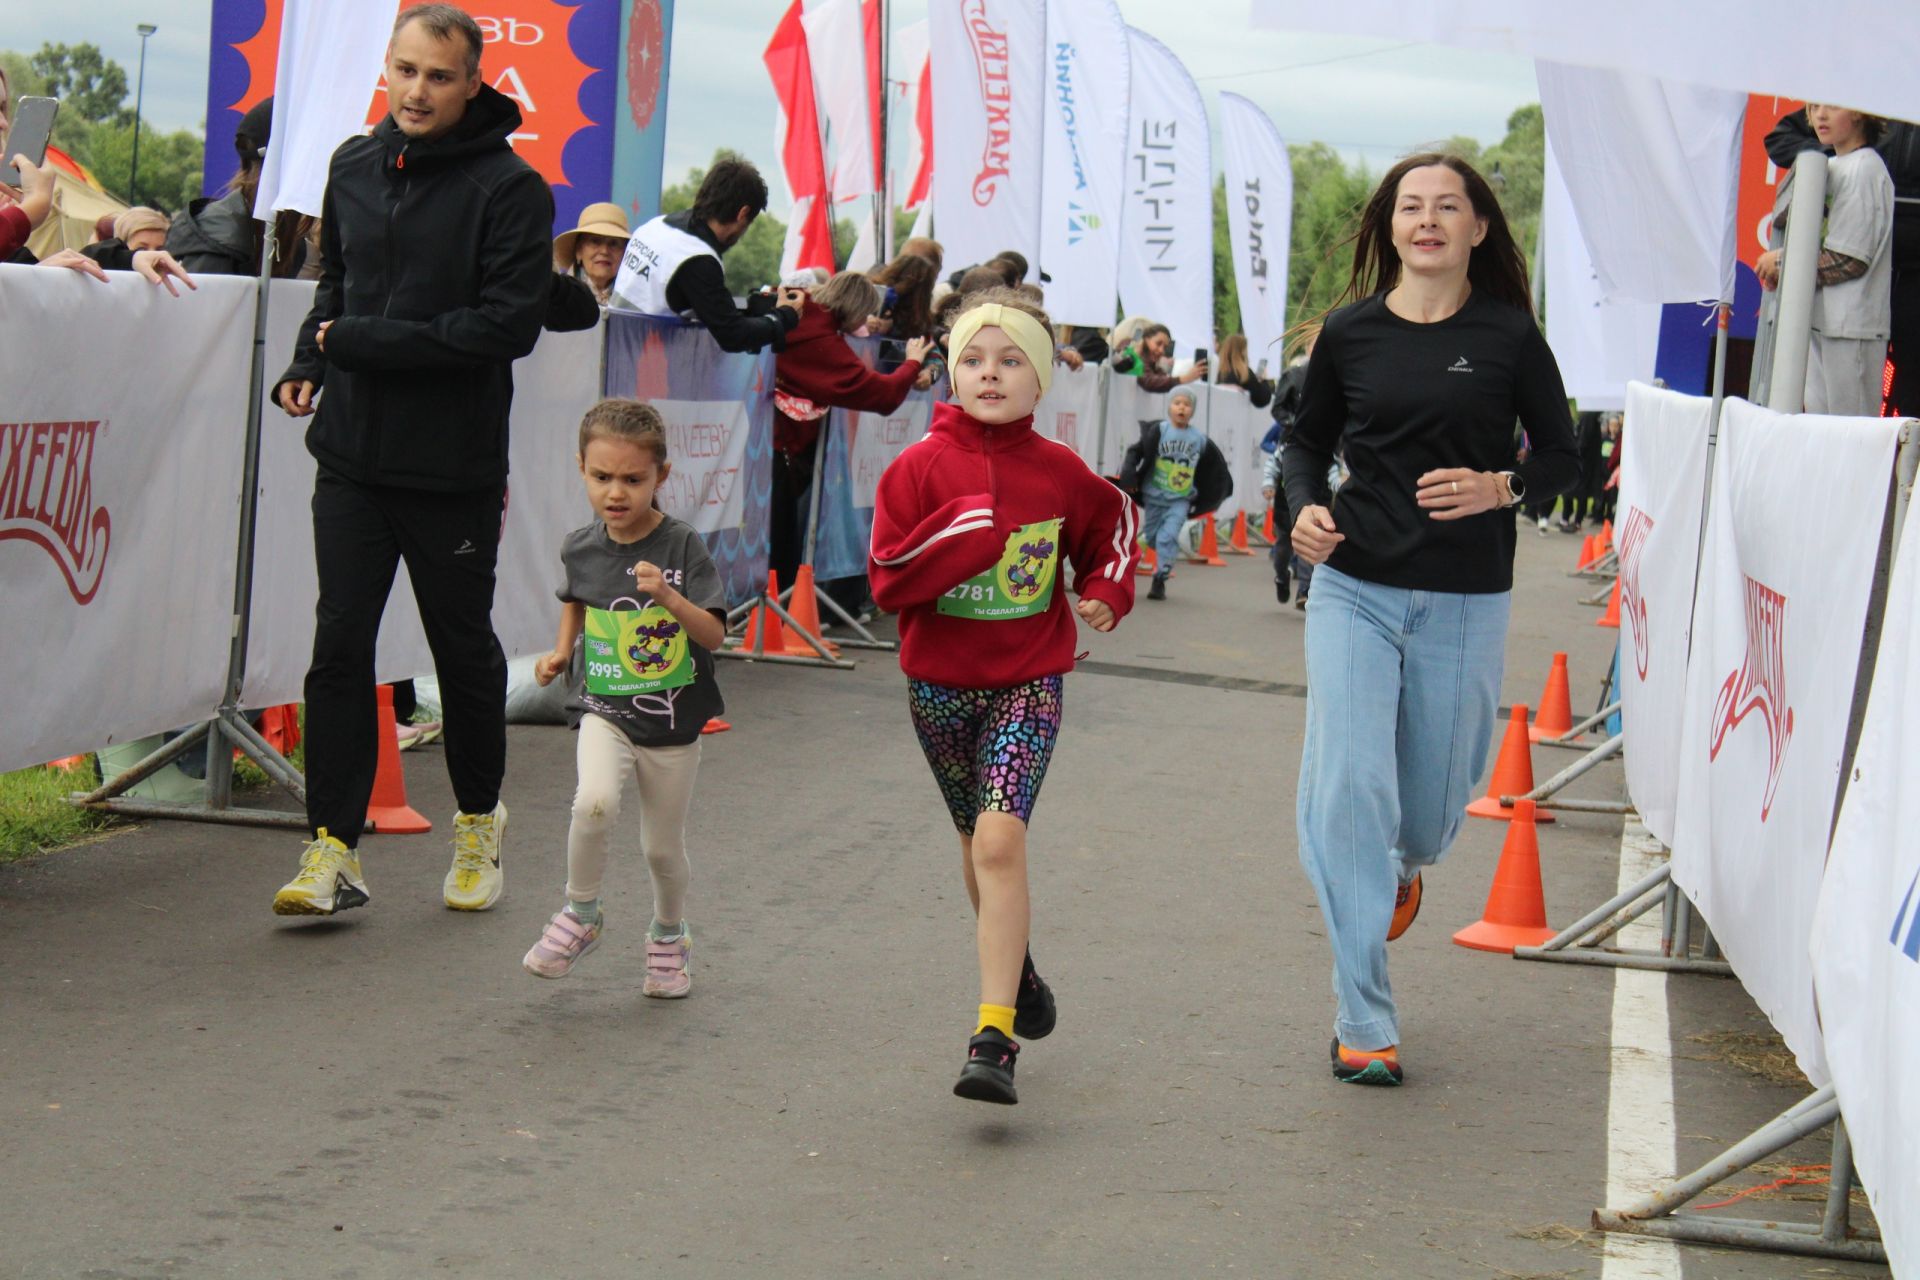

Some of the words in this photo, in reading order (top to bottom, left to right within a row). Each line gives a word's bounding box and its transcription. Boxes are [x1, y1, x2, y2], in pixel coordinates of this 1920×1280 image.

[630, 238, 660, 267] OFFICIAL
[944, 584, 994, 602] 2781
[986, 607, 1015, 615] СДЕЛАЛ
[588, 660, 623, 679] 2995
